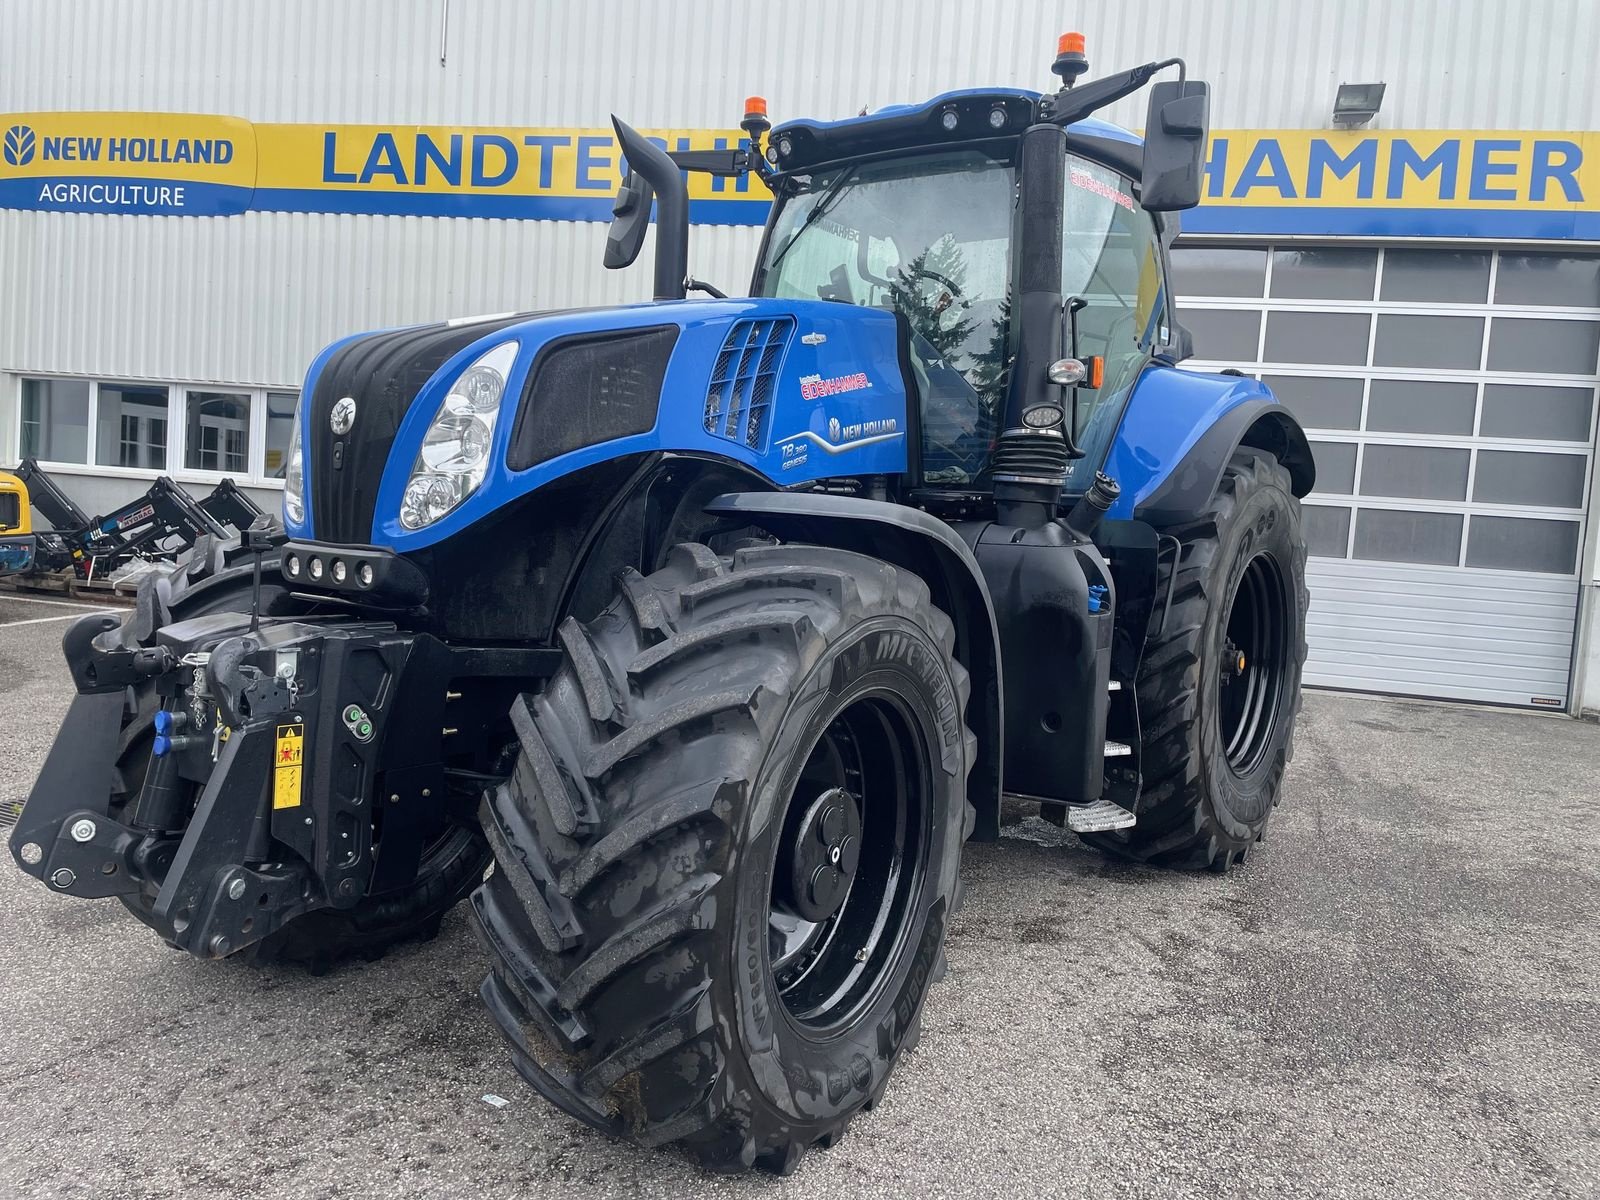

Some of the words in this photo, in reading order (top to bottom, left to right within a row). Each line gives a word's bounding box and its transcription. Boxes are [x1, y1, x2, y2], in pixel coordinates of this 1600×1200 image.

[42, 136, 103, 161] NEW
[108, 138, 234, 165] HOLLAND
[38, 183, 185, 207] AGRICULTURE
[800, 372, 868, 400] EIDENHAMMER
[842, 424, 861, 441] NEW
[863, 418, 897, 436] HOLLAND
[123, 509, 153, 527] HYDRAC
[875, 633, 959, 747] MICHELIN
